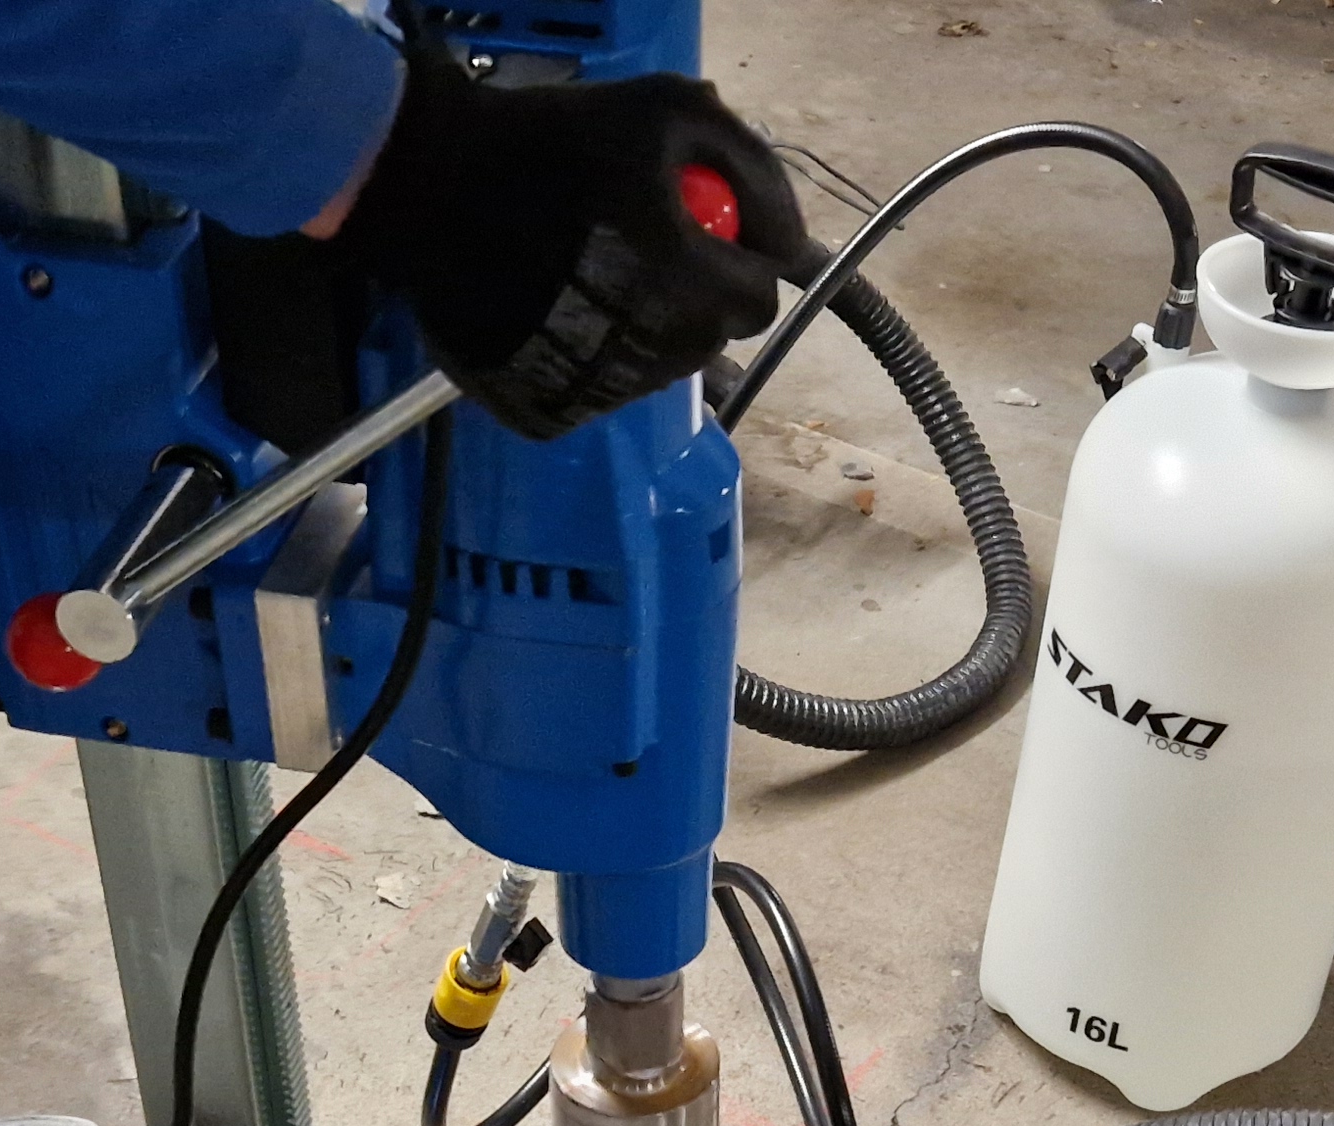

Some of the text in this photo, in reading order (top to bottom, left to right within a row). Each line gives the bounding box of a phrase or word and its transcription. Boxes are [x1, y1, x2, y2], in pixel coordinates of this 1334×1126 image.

[1047, 628, 1229, 749] STAKO
[1144, 732, 1208, 761] TOOLS
[1066, 1006, 1129, 1052] 16L
